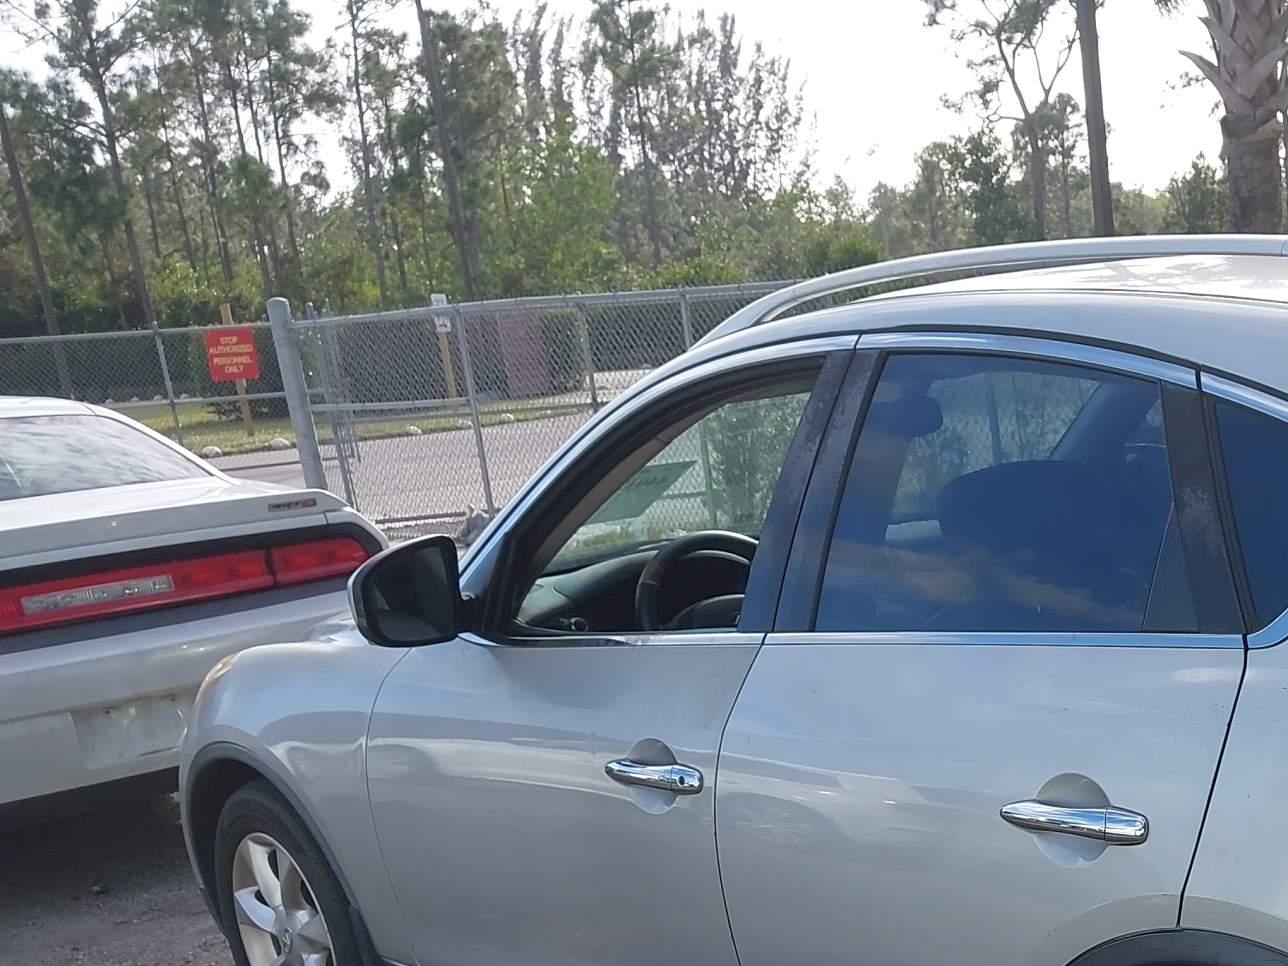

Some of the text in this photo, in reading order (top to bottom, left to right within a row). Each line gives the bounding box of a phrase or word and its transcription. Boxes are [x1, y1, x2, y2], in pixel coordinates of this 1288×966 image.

[220, 336, 238, 345] STOP
[209, 344, 253, 354] AUTHORIZED
[213, 356, 252, 365] PERSONNEL
[225, 365, 244, 373] ONLY
